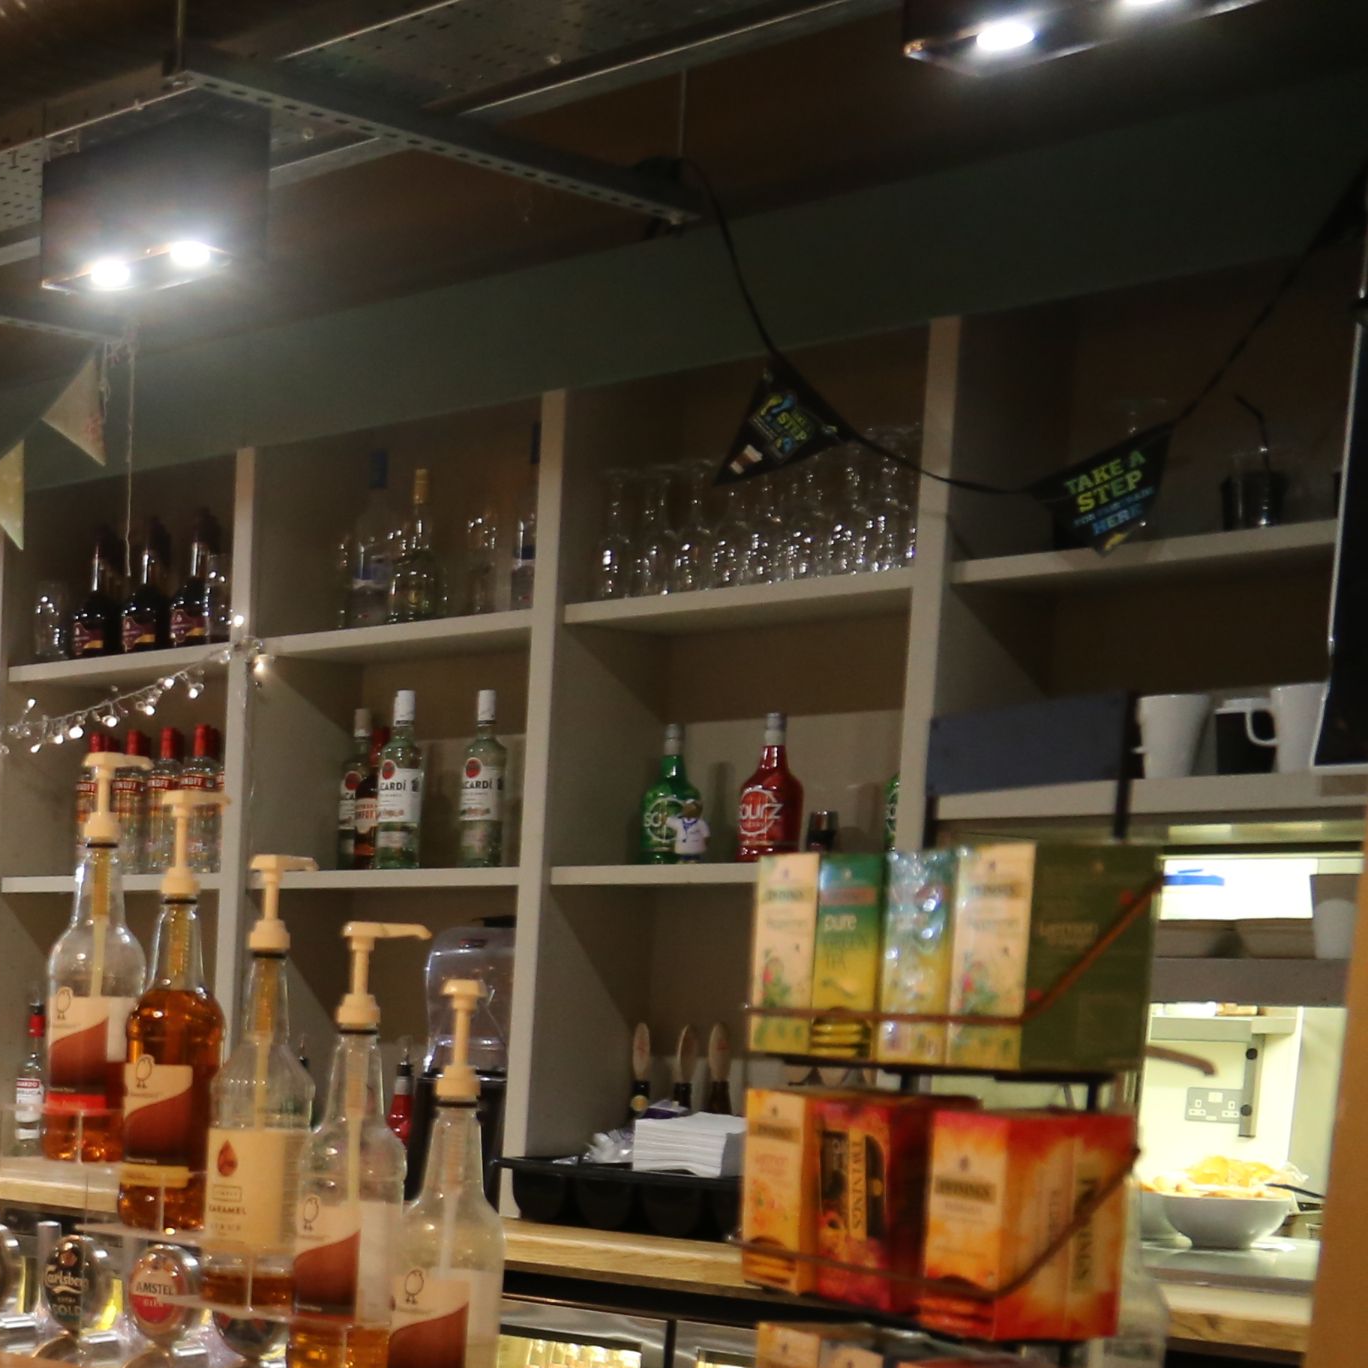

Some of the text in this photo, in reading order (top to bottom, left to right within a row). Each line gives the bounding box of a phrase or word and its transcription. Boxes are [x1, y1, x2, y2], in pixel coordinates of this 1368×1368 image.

[1064, 449, 1147, 496] TAKE A
[1077, 468, 1144, 513] STEP
[738, 802, 784, 821] ourz
[824, 913, 857, 931] pure
[848, 1141, 866, 1231] TWININGS
[45, 1264, 90, 1289] Carlsberg
[136, 1282, 174, 1295] AMSTEL
